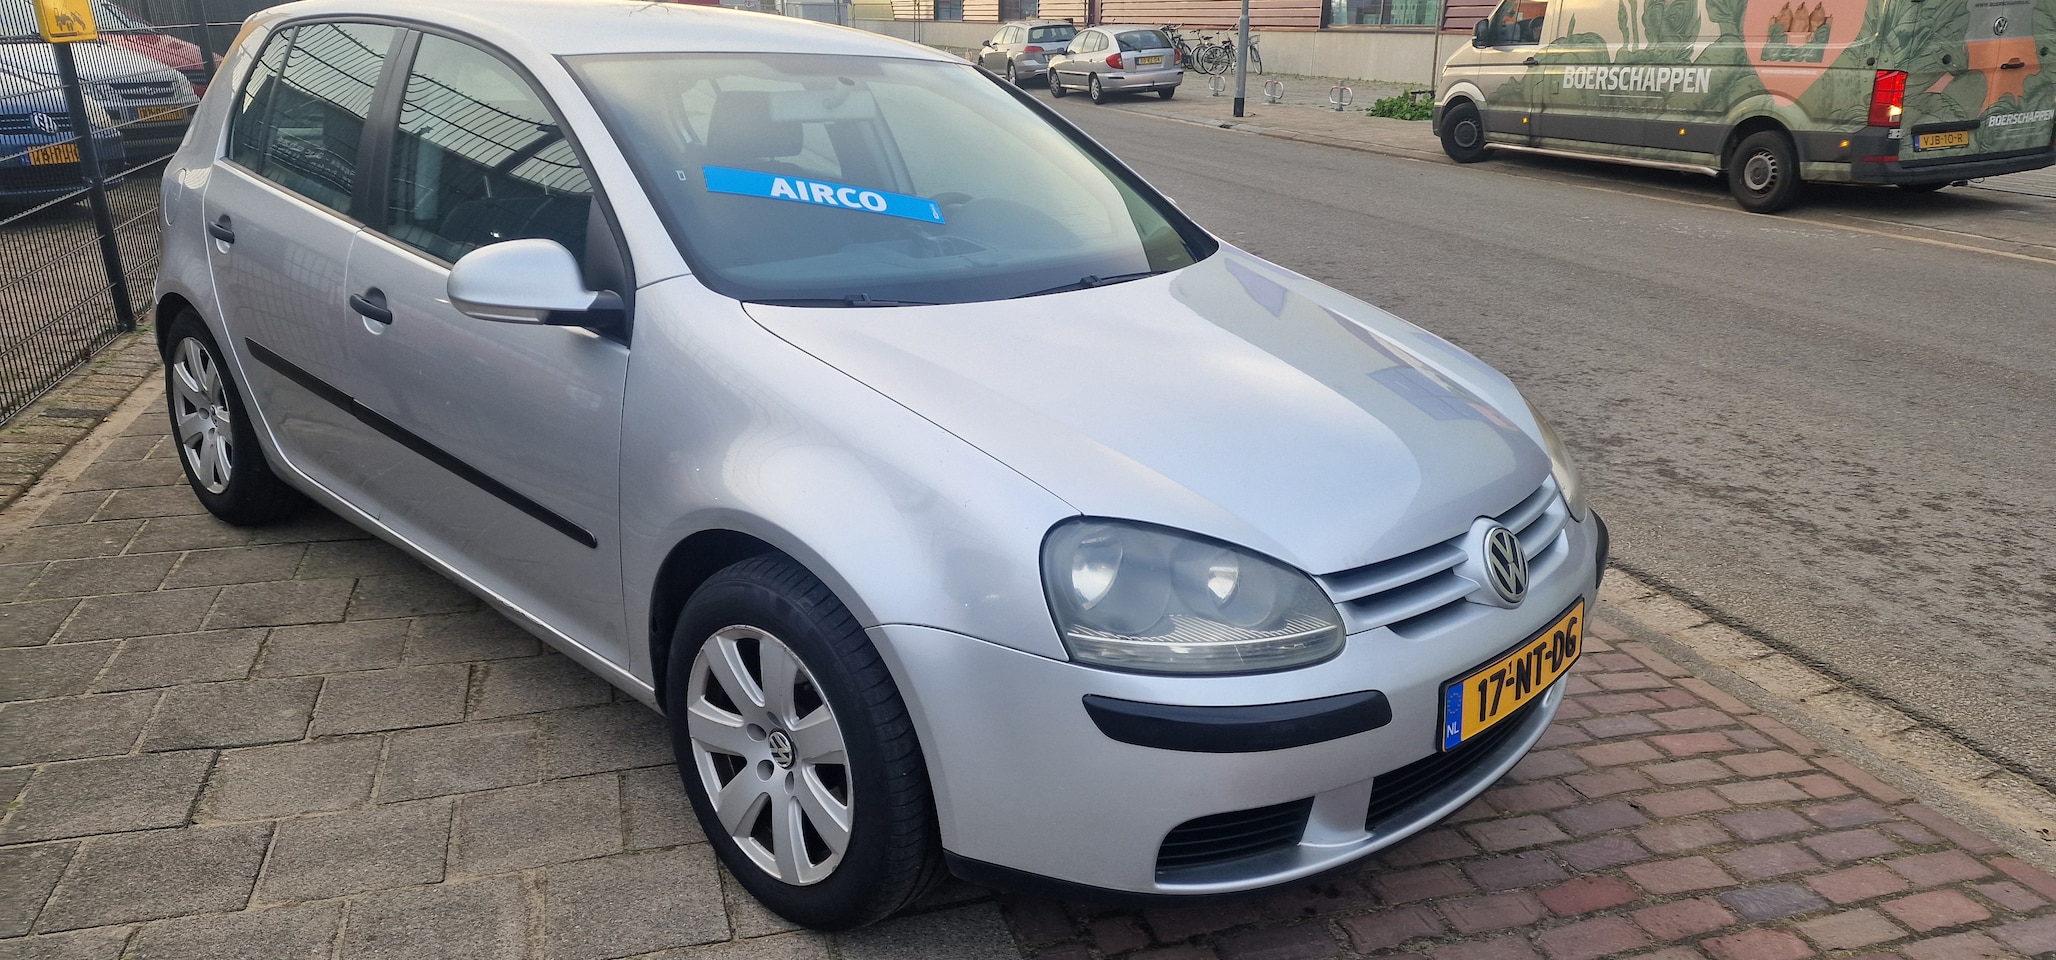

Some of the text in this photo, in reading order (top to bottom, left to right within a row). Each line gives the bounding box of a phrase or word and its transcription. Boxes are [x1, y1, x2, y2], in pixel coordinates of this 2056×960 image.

[1562, 66, 1712, 93] BOERSCHAPPEN
[1988, 109, 2055, 127] BOERSCHAPPEN
[1923, 133, 1963, 146] VJB-10-R
[770, 177, 888, 212] AIRCO
[1446, 721, 1460, 738] NL
